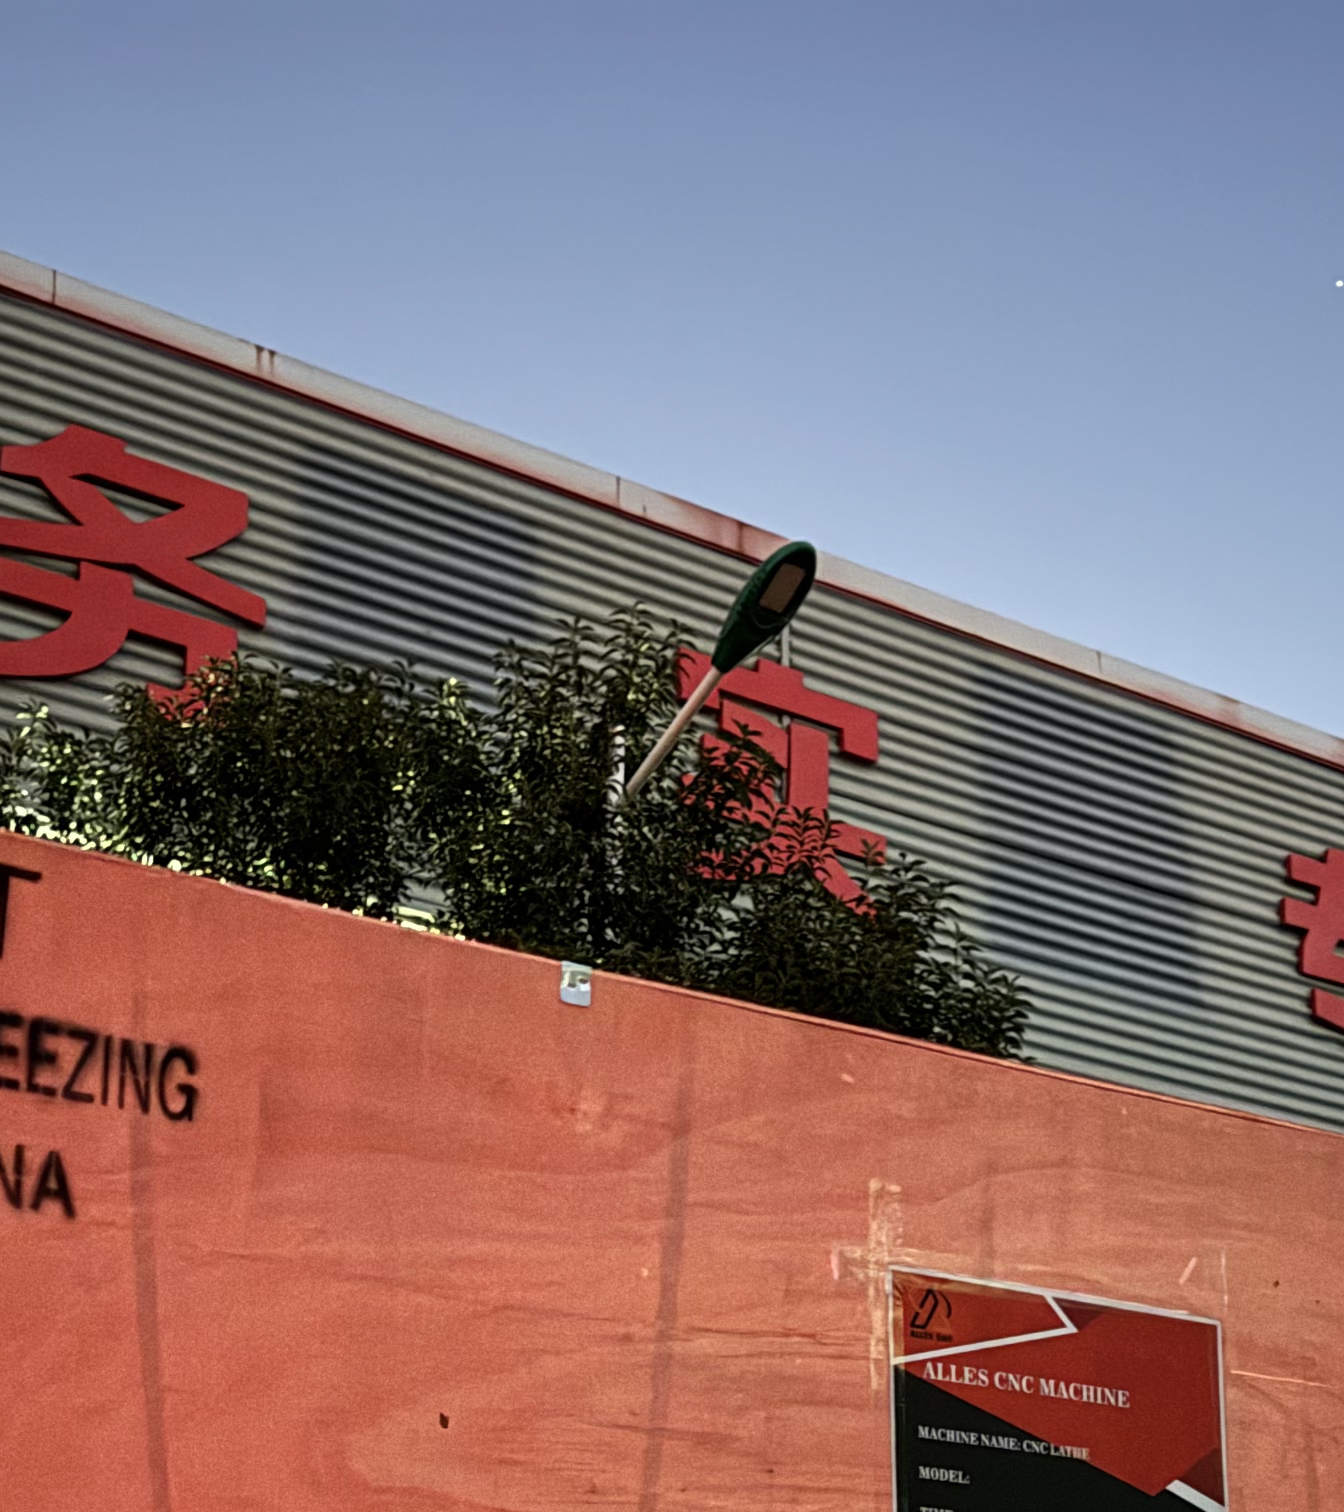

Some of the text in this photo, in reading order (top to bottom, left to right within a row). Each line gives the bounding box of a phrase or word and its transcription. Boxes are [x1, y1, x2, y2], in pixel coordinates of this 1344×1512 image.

[922, 1361, 1131, 1408] ALLES CNC MACHINE
[918, 1425, 1090, 1460] MACHINE NAME: CNC LATHE
[918, 1466, 970, 1484] MODEL:
